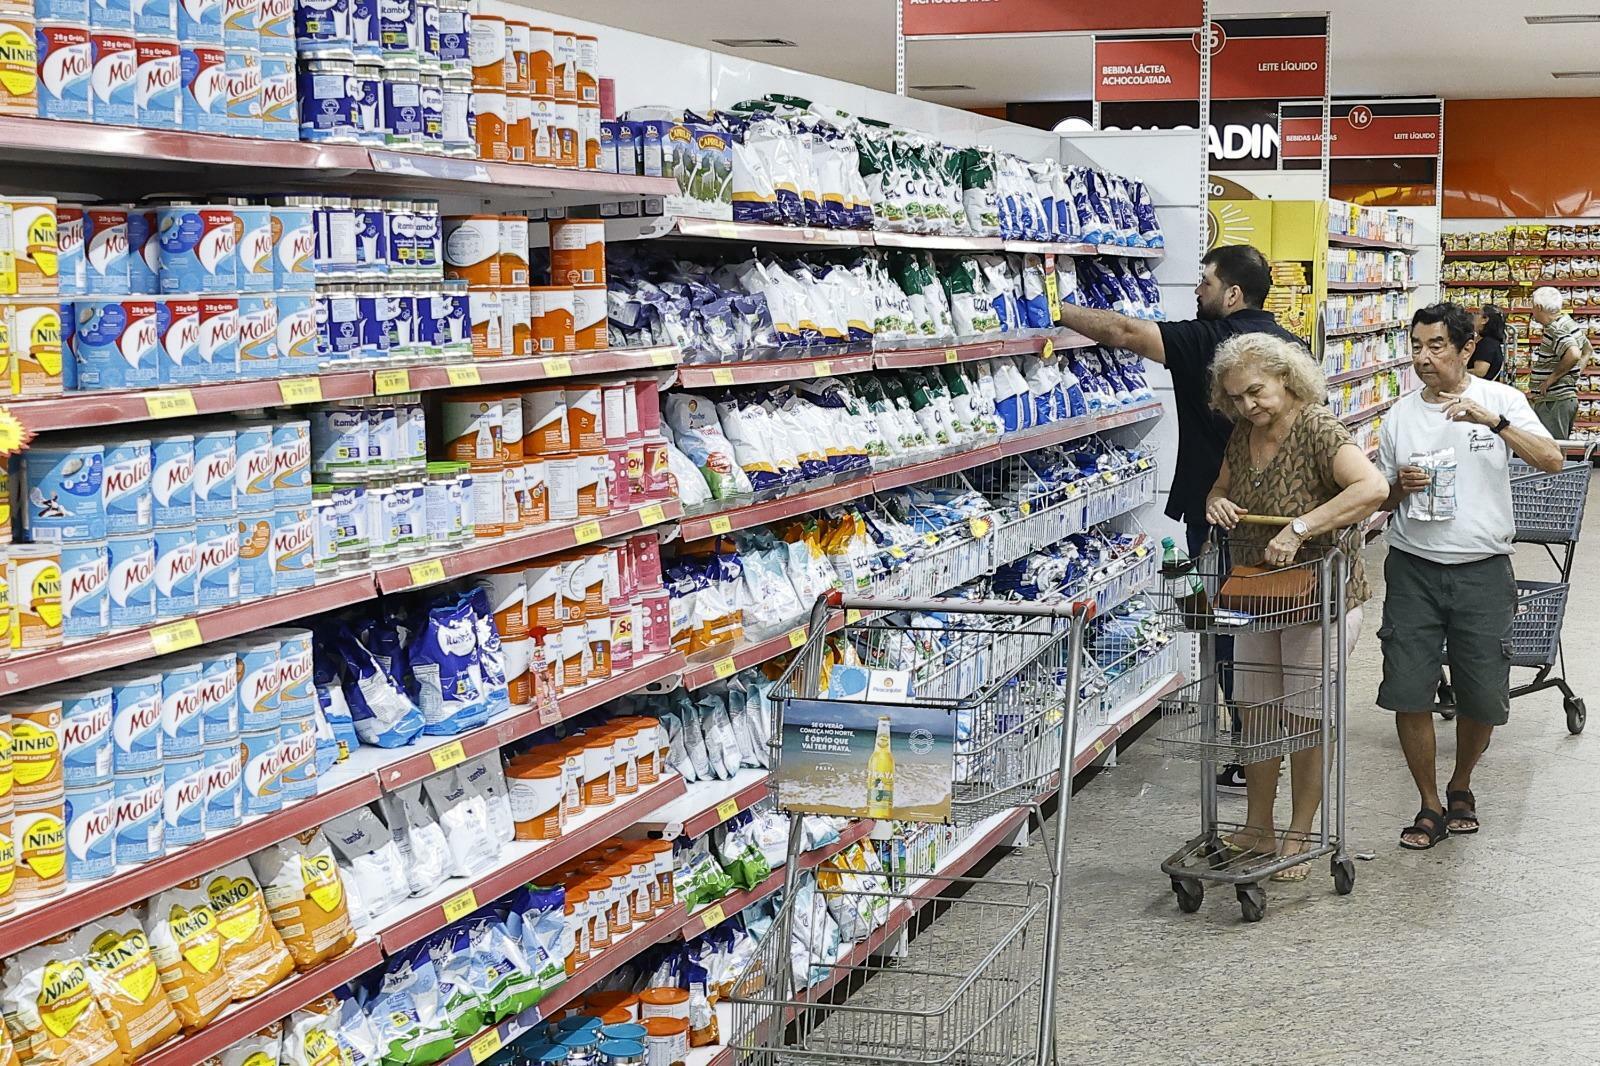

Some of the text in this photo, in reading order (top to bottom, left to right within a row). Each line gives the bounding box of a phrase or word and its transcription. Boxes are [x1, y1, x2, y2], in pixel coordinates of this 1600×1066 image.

[1102, 64, 1166, 75] BEBIDA LÁCTEA
[1258, 60, 1318, 72] LEITE LÍQUIDO
[1102, 75, 1171, 85] ACHOCOLATADA
[1353, 111, 1368, 124] 16
[1312, 133, 1337, 142] LÁCAS
[1409, 132, 1435, 140] LÍQUIDO
[416, 222, 434, 231] ambé
[824, 721, 844, 730] VERÃO
[800, 727, 824, 736] COMEÇA
[804, 734, 810, 743] É
[834, 737, 849, 746] QUE
[814, 743, 827, 751] TER
[45, 966, 85, 1004] NINHO
